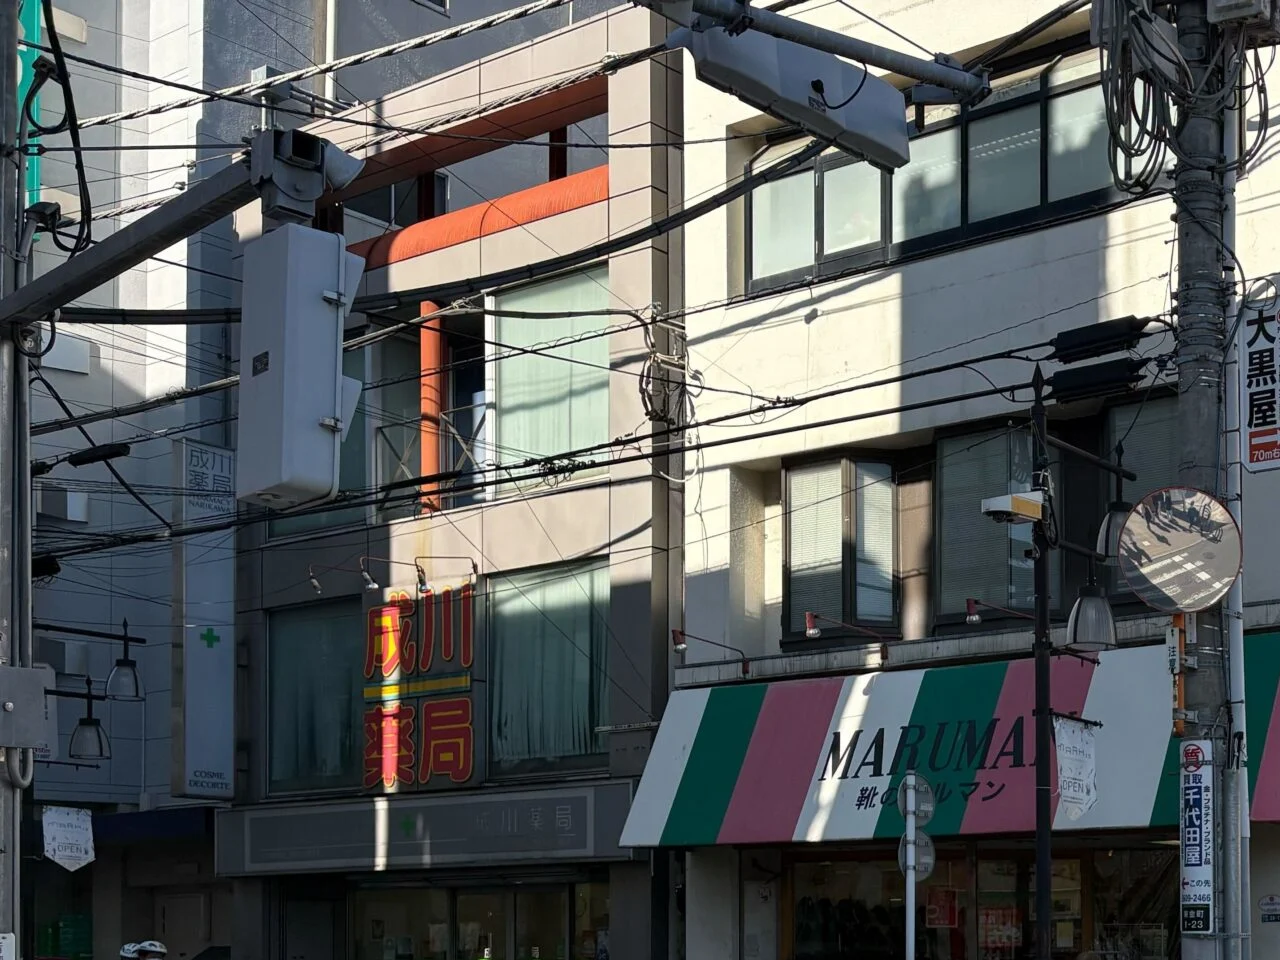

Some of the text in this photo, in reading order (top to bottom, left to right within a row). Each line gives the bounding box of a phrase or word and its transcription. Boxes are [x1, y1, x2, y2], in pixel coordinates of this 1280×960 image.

[1246, 308, 1277, 429] 大黒屋
[188, 448, 232, 475] 成川
[188, 470, 232, 492] 薬局
[364, 580, 474, 679] 成川
[364, 698, 474, 788] 薬局
[856, 781, 1006, 811] 靴のルマン
[1062, 780, 1085, 793] OPEN
[1185, 788, 1201, 866] 千代田屋
